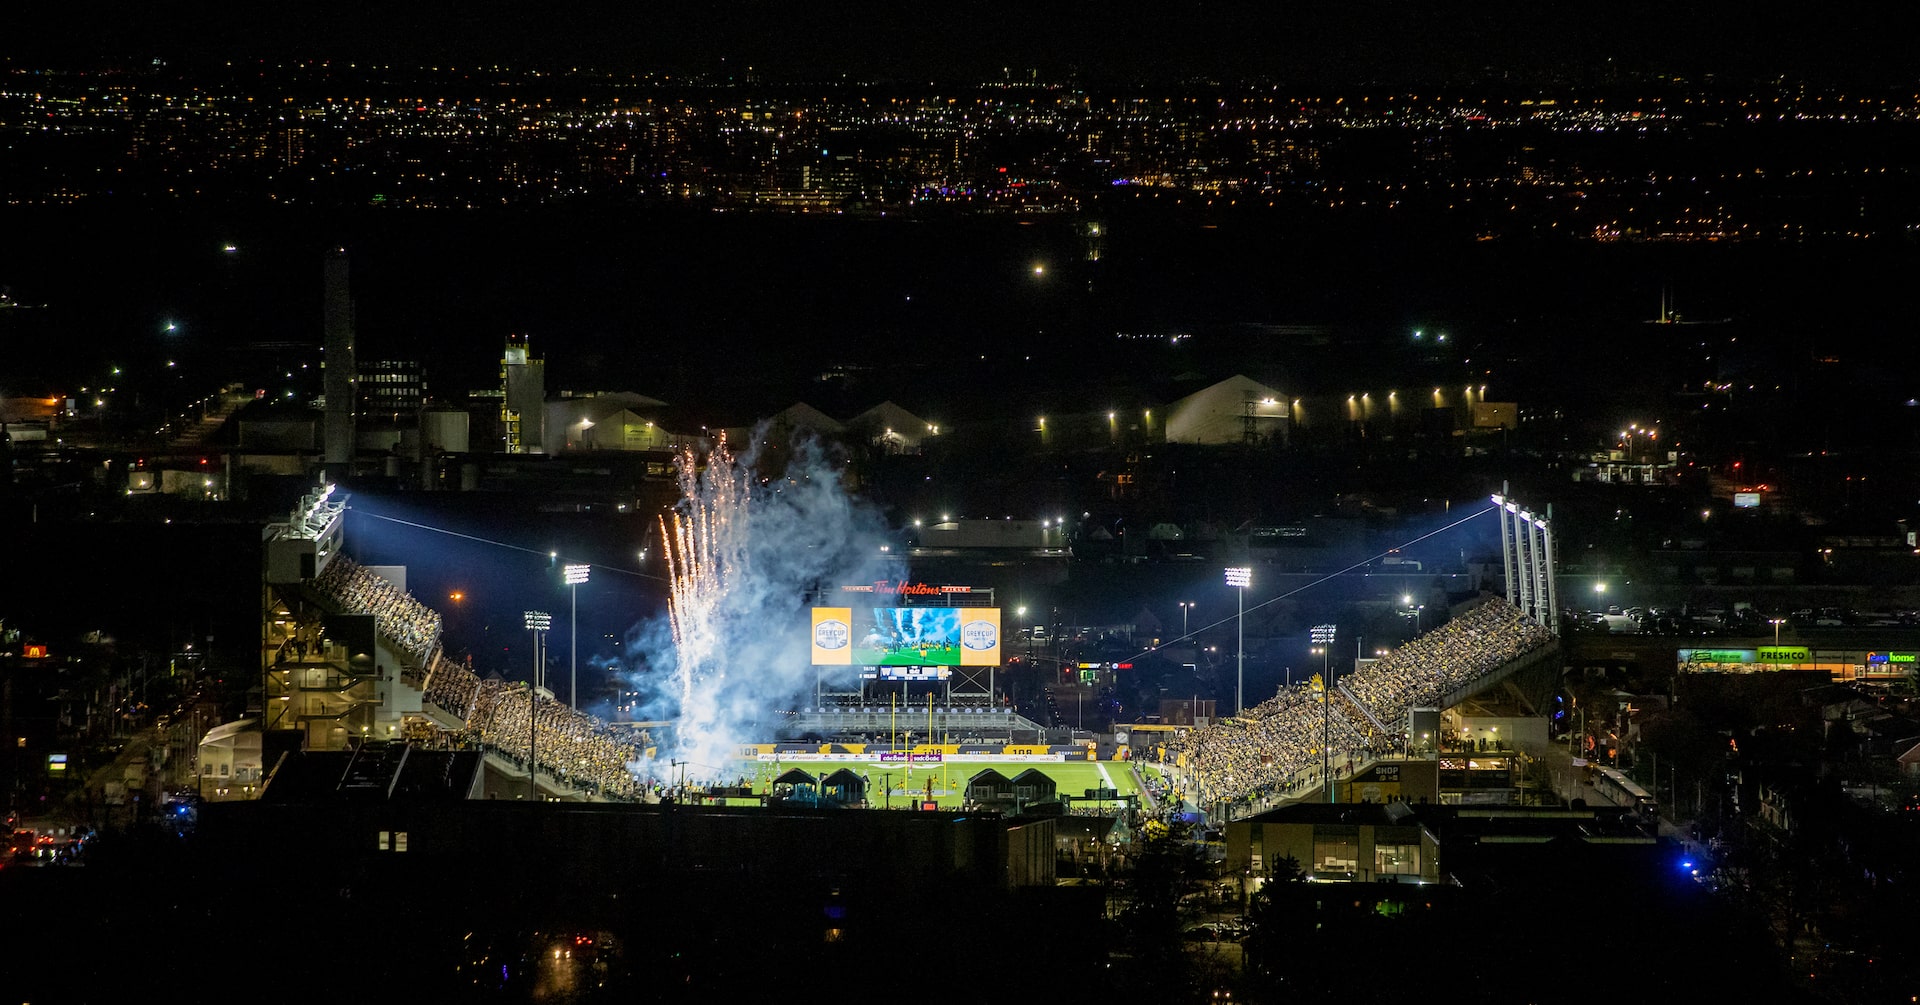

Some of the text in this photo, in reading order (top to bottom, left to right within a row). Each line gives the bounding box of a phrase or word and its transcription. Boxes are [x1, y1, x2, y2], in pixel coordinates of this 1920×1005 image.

[873, 580, 895, 594] Tim
[896, 580, 940, 595] Hortons
[740, 748, 758, 756] 108
[1376, 767, 1399, 775] SHOP
